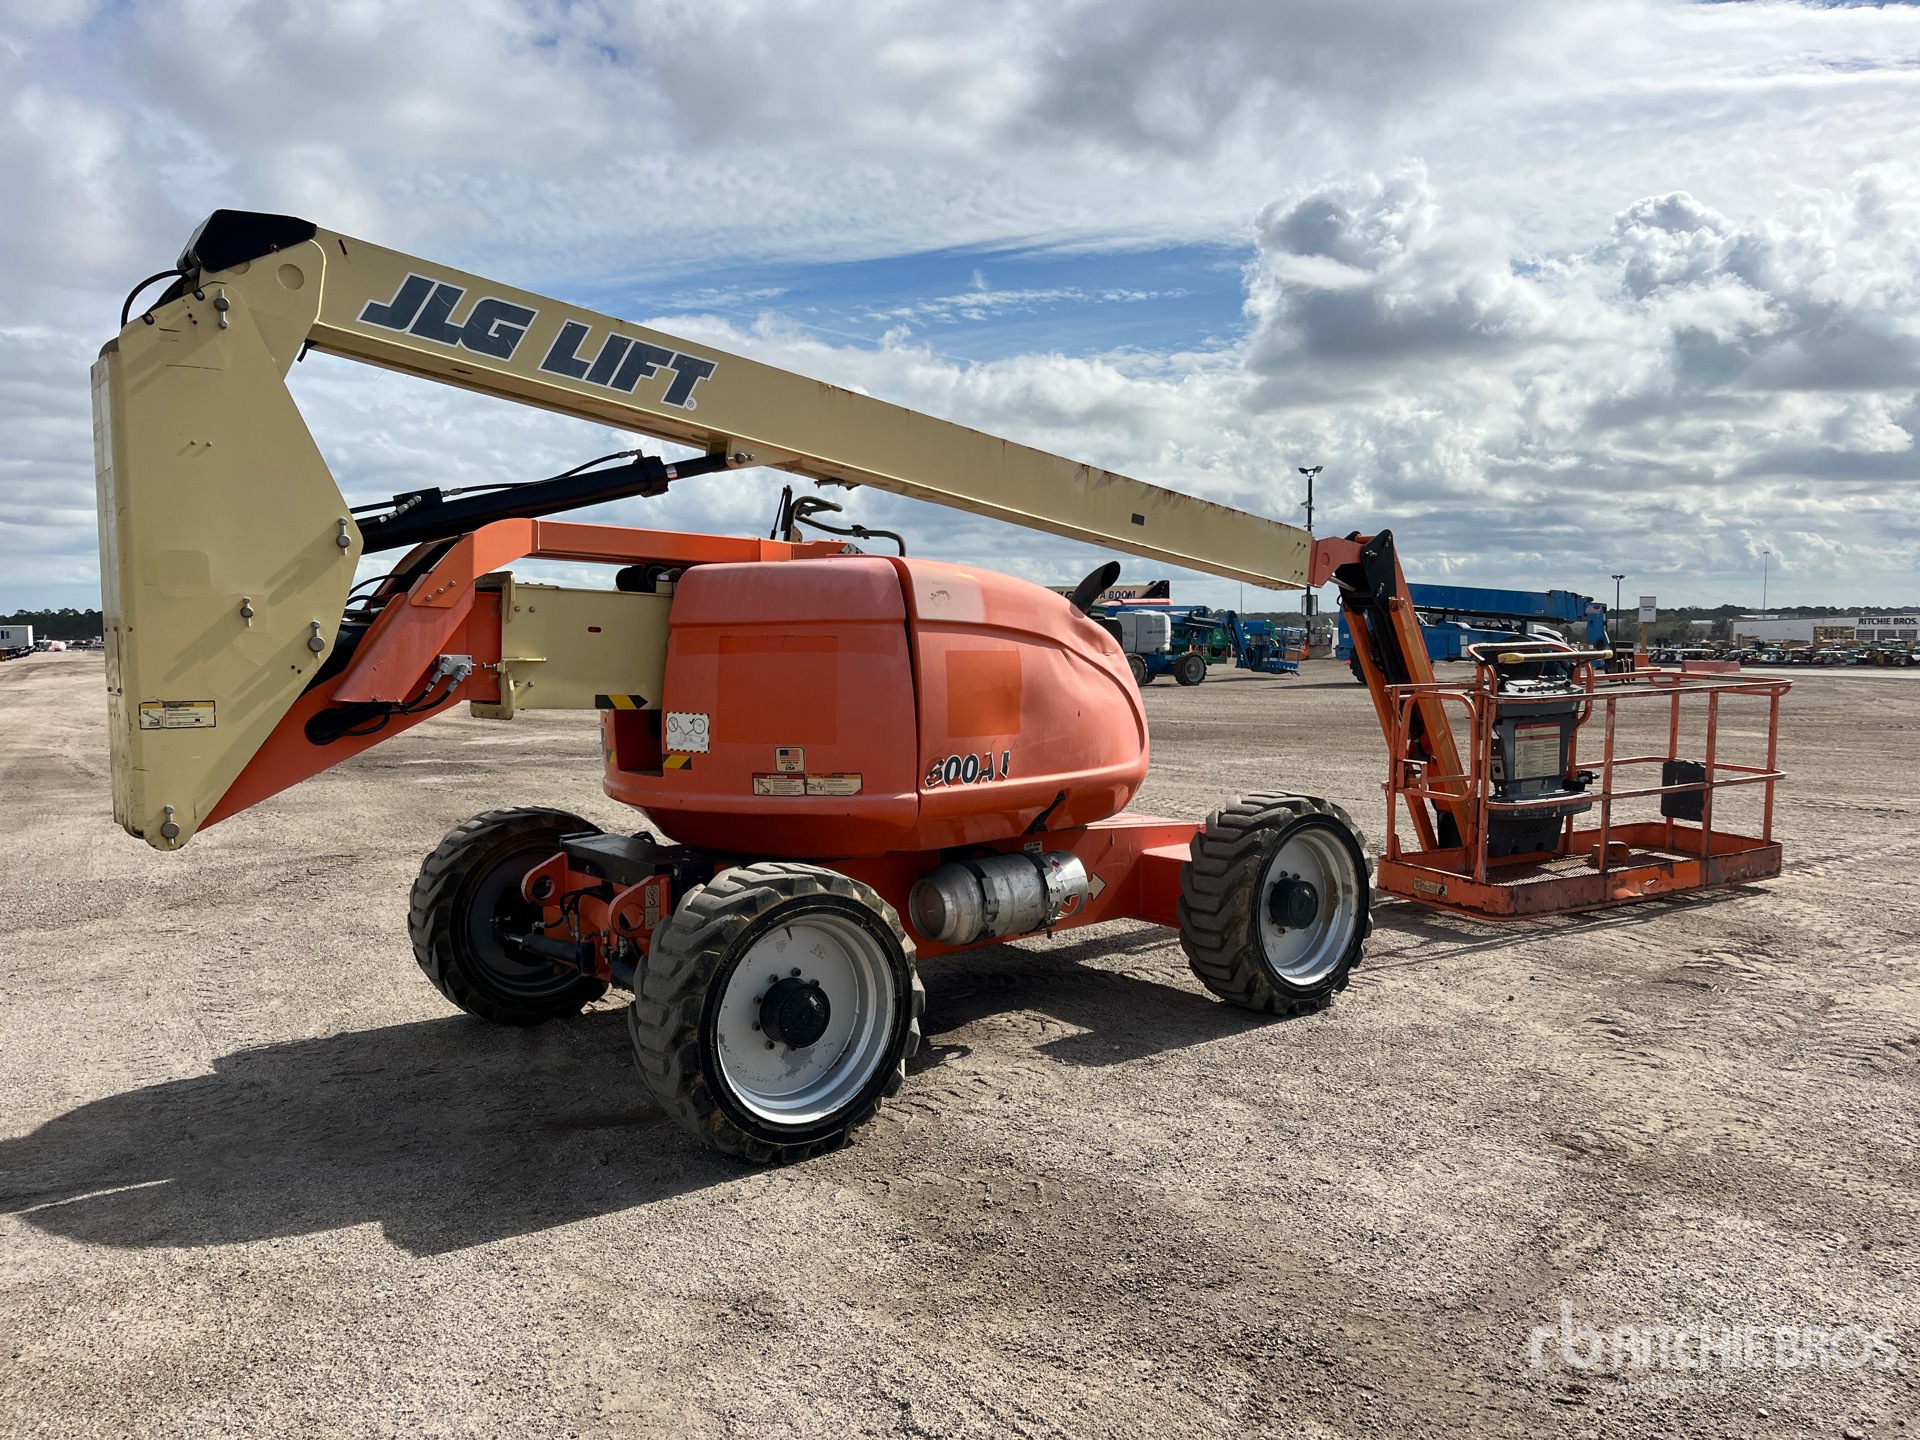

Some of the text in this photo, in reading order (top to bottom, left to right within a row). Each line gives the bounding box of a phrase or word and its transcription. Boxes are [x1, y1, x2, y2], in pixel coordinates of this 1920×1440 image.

[356, 272, 540, 362] JLG
[1108, 590, 1136, 600] BOOM
[1858, 617, 1919, 625] RITCHIE BROS.
